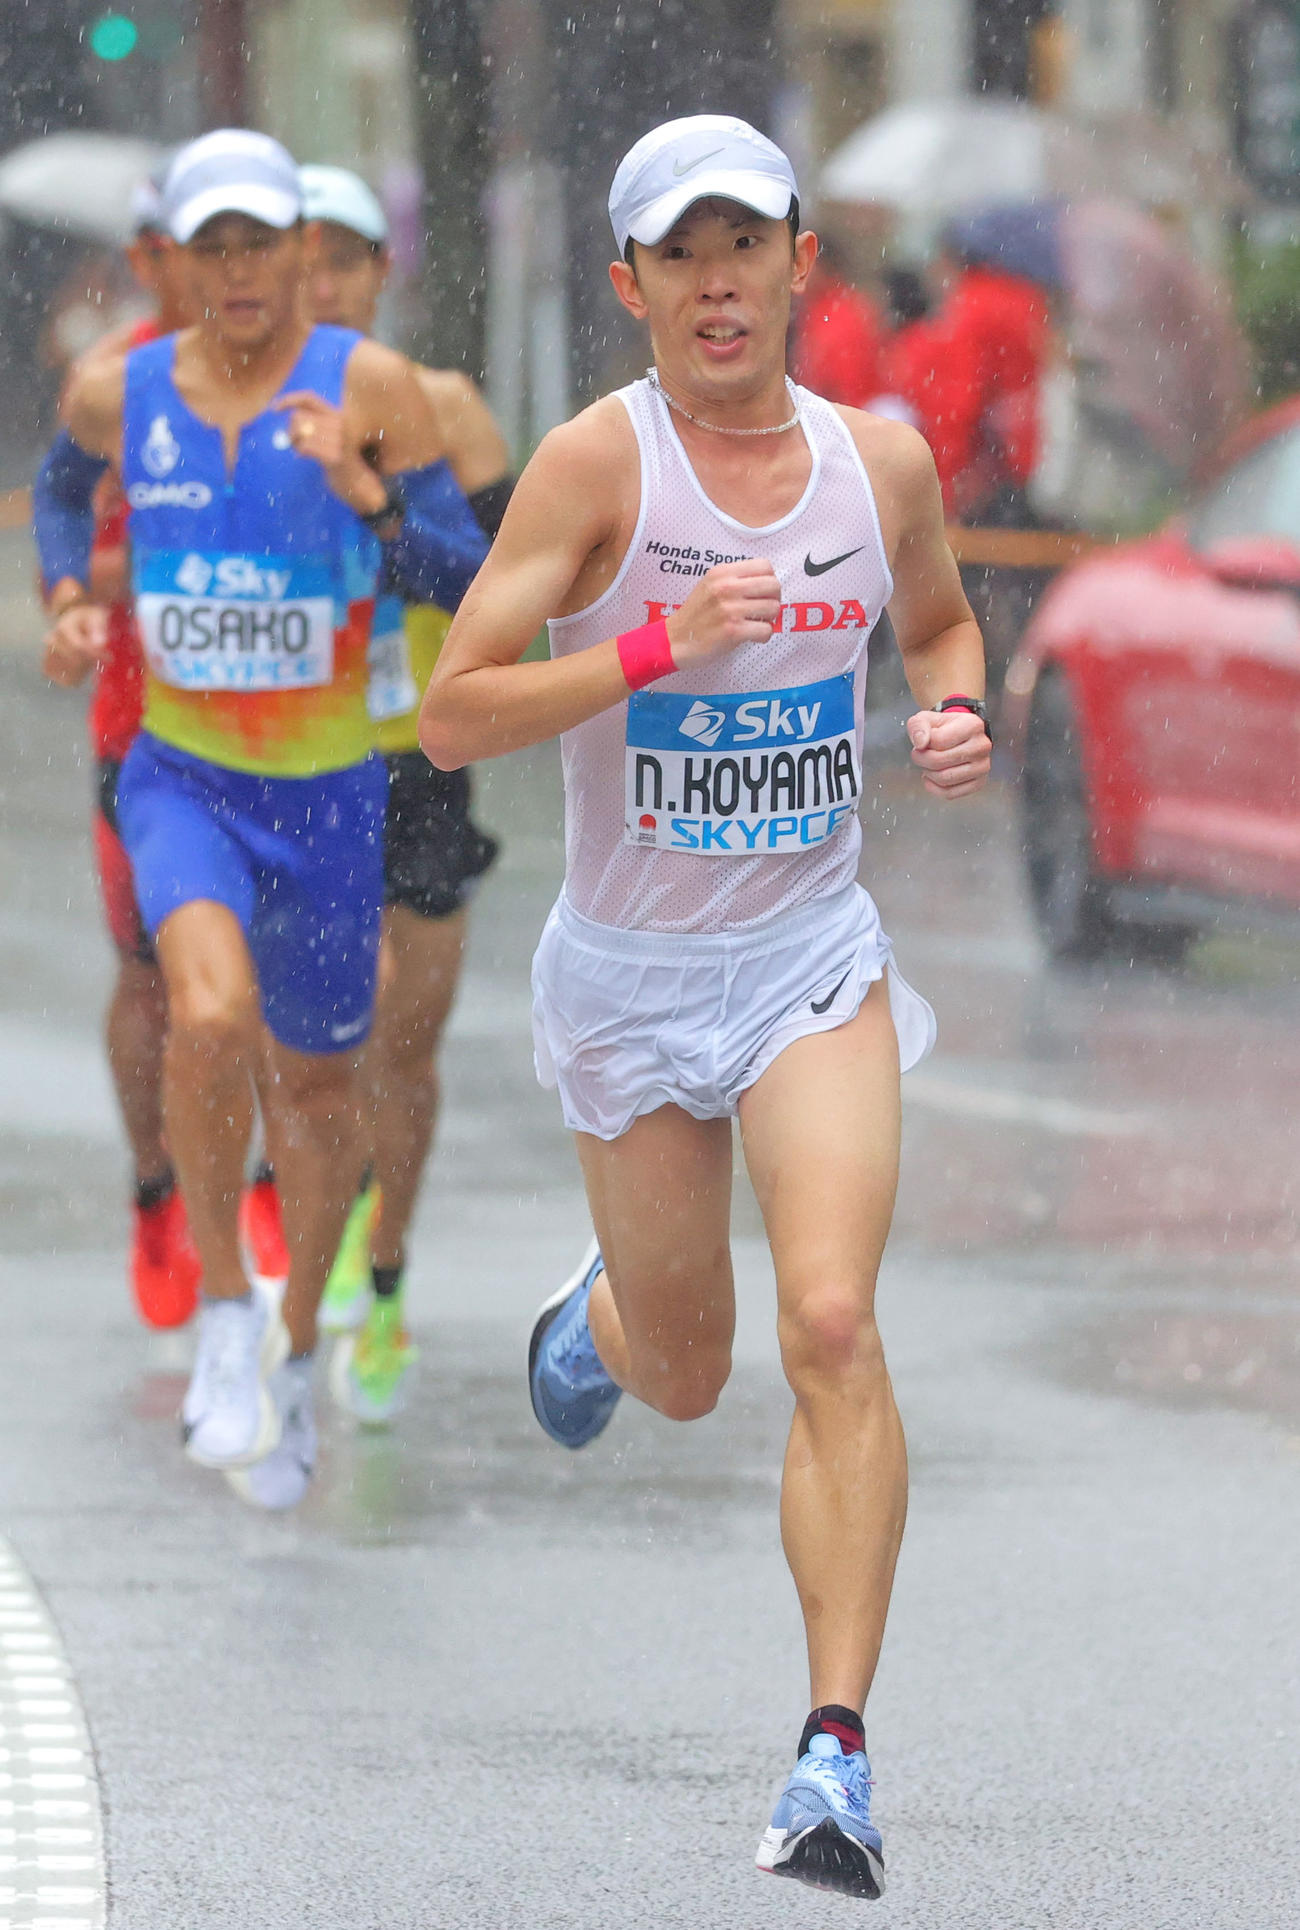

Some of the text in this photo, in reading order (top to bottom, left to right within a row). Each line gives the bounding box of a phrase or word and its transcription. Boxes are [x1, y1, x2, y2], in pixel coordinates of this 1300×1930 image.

[645, 541, 701, 561] Honda
[213, 558, 293, 600] Sky
[159, 605, 310, 653] OSAKO
[733, 700, 822, 742] Sky
[670, 804, 852, 850] SKYPCE
